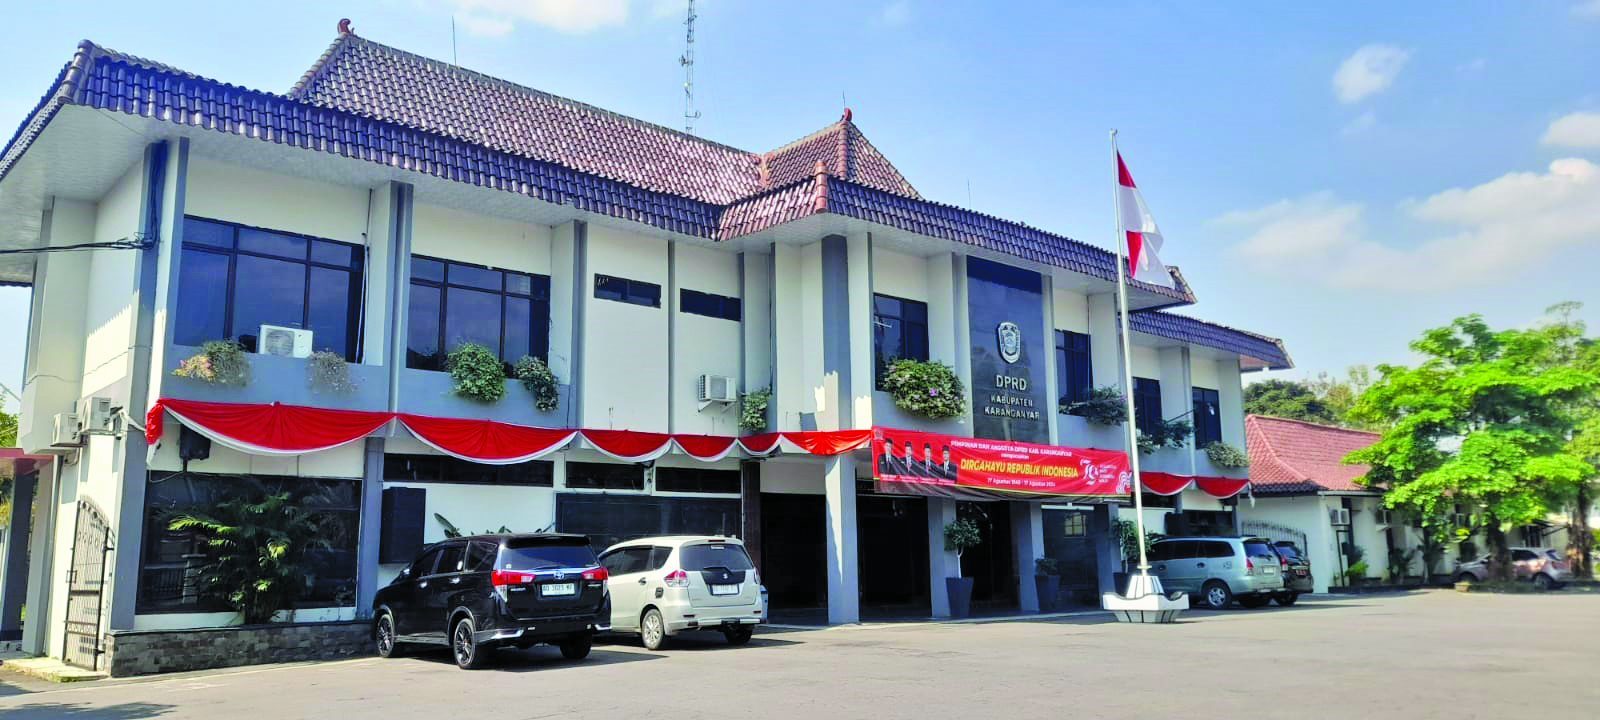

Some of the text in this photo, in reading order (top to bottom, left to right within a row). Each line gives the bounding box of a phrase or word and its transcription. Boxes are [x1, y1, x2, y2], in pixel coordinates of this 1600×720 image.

[996, 375, 1027, 390] DPRD
[991, 395, 1033, 407] KABUPATEN
[984, 407, 1039, 419] KARANGANYAR
[961, 459, 1078, 477] DIRGAHAYU REPUBLIK INDONESIA
